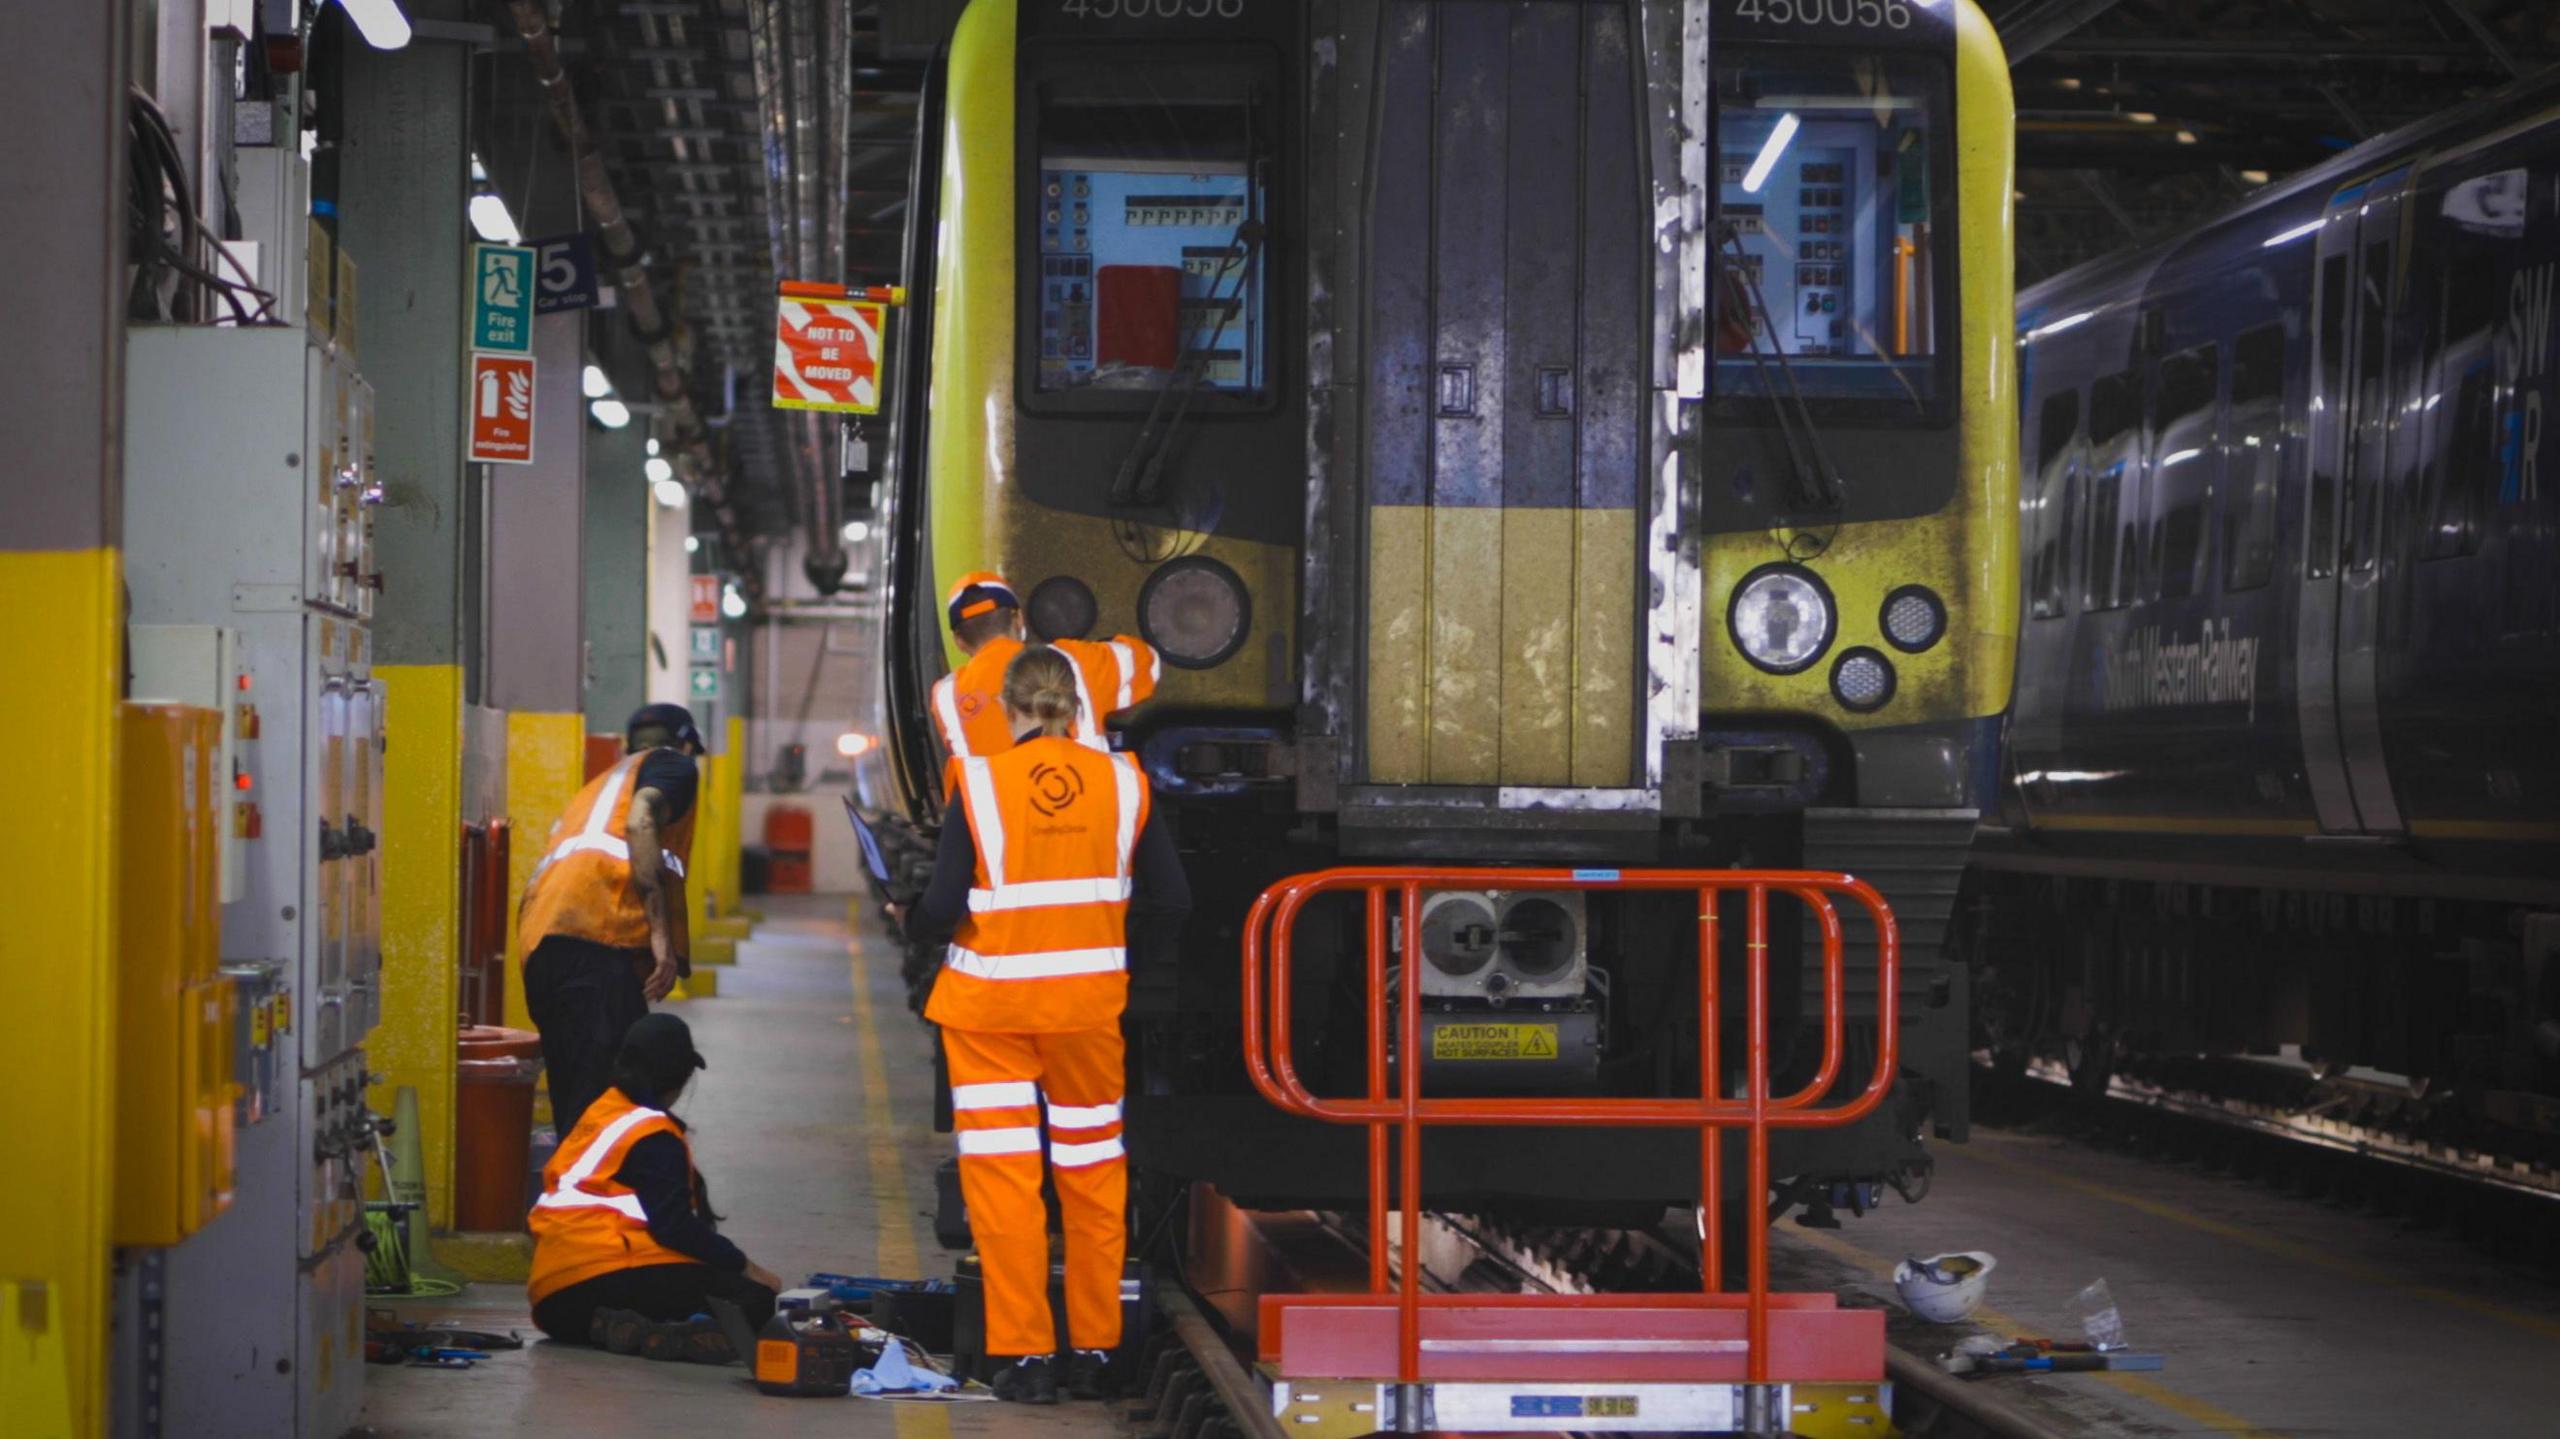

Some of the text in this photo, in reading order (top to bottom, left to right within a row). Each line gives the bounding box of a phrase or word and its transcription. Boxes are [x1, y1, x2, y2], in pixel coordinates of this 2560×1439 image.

[1735, 0, 1911, 29] 450056
[541, 242, 577, 292] 5
[488, 312, 516, 327] Fire
[2506, 262, 2555, 383] SW
[488, 328, 515, 343] exit
[807, 327, 855, 342] NOT TO
[821, 347, 839, 360] BE
[805, 365, 852, 381] MOVED
[493, 428, 510, 438] Fire
[475, 440, 527, 452] extinguisher
[2201, 617, 2259, 723] Railway
[1437, 1026, 1509, 1039] CAUTION
[1437, 1048, 1519, 1057] HOT SURFACES
